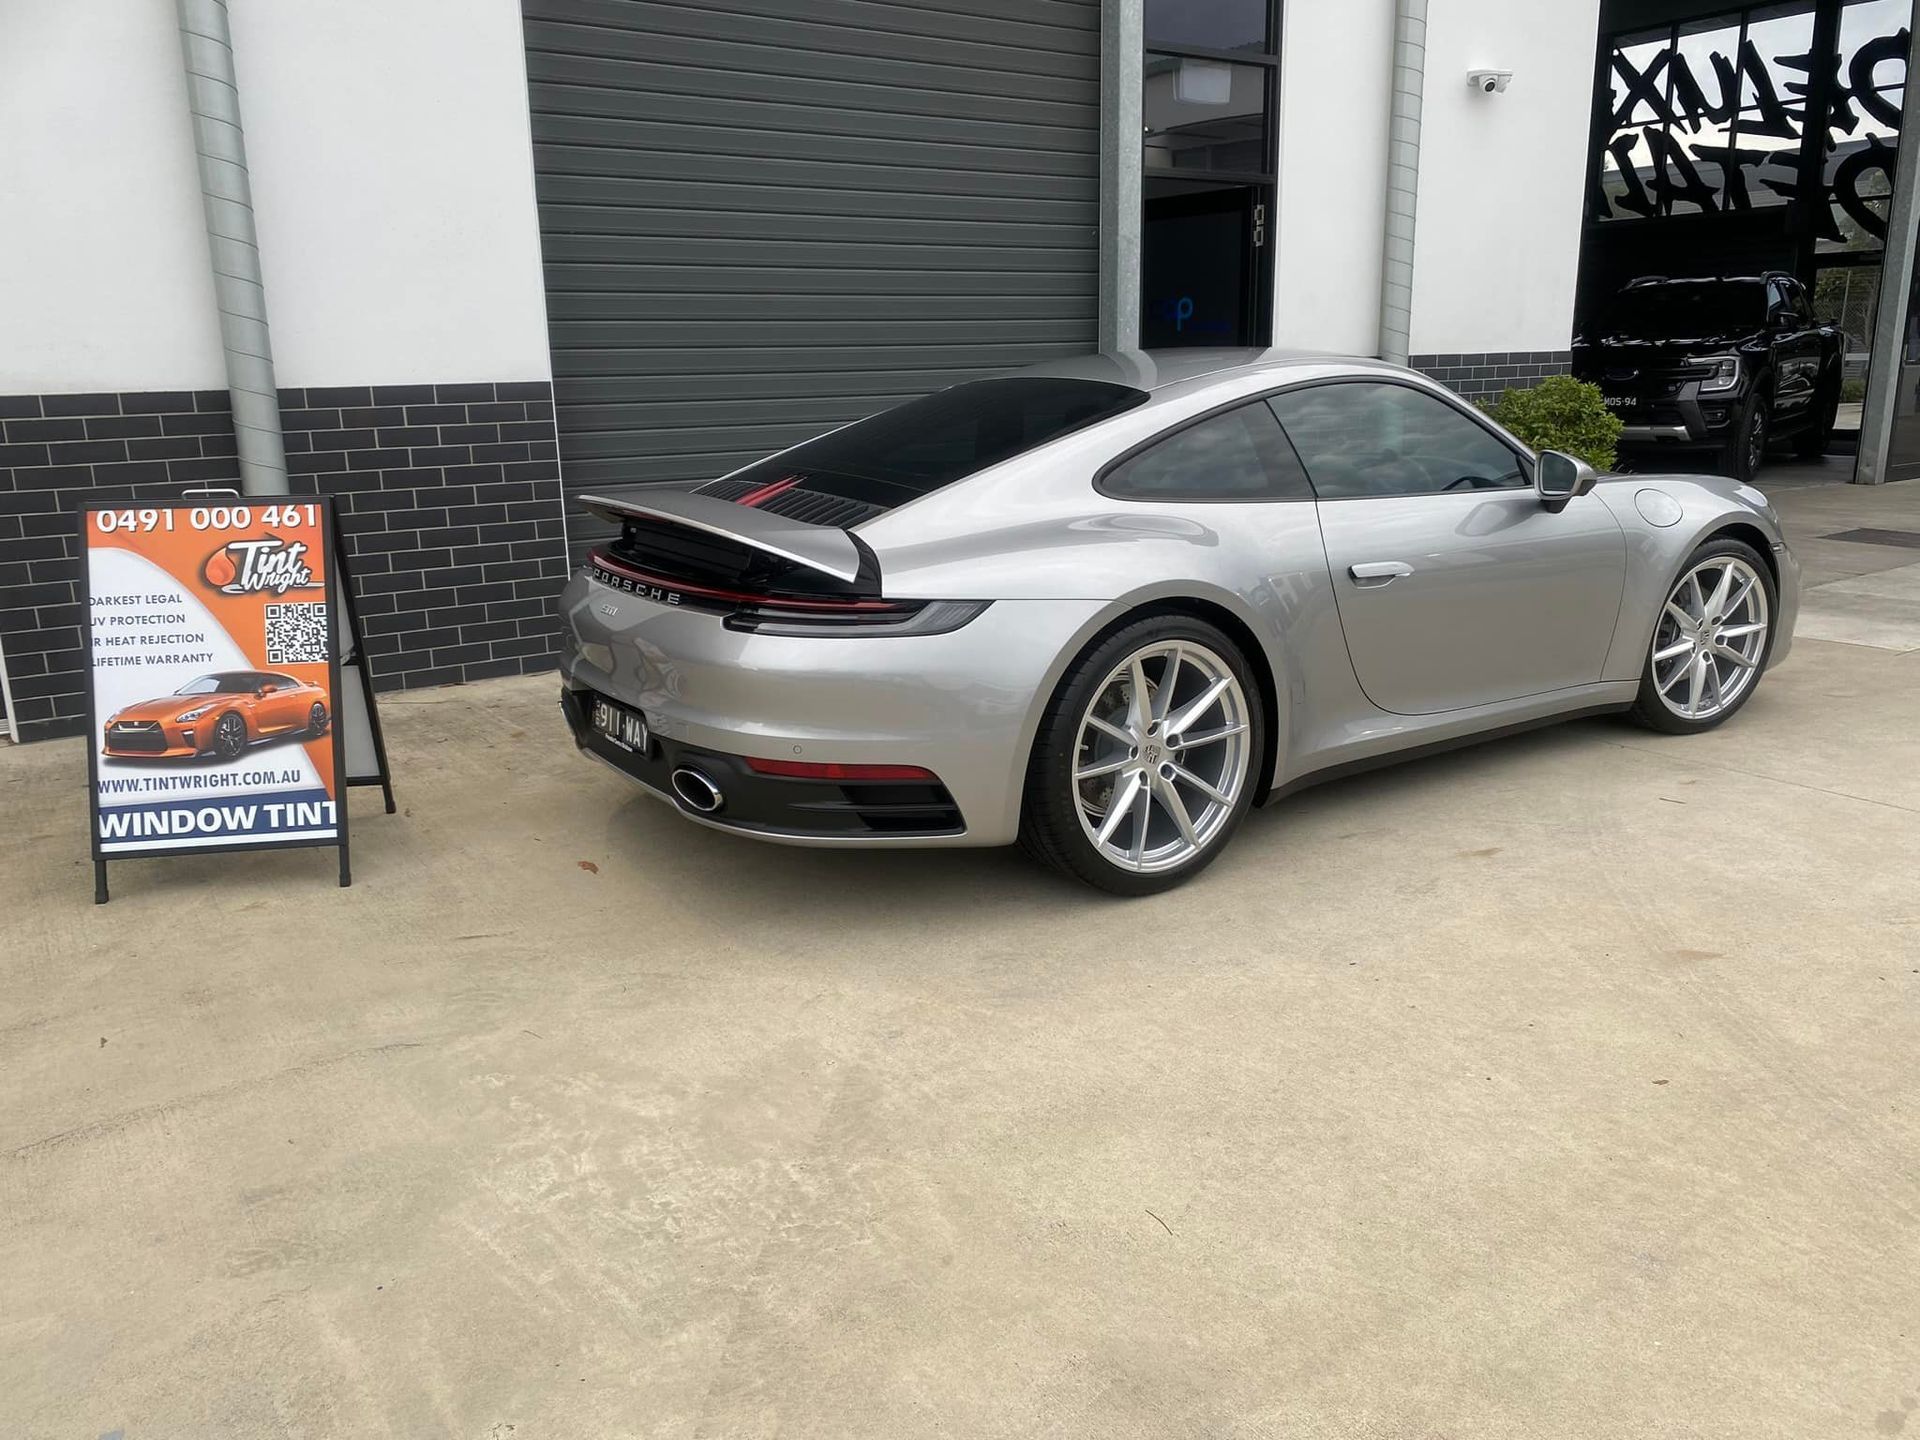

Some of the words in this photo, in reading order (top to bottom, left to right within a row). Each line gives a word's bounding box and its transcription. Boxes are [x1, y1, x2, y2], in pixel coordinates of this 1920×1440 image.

[96, 507, 174, 532] 0491
[190, 505, 251, 530] 000
[261, 504, 316, 528] 461
[227, 540, 307, 586] Tint
[244, 567, 311, 593] Wright
[593, 569, 681, 605] PORSCHE
[89, 595, 141, 606] DARKEST
[146, 594, 182, 604] LEGAL
[600, 604, 618, 616] 911
[110, 614, 186, 626] PROTECTION
[106, 636, 136, 646] HEAT
[140, 633, 204, 645] REJECTION
[145, 653, 213, 665] WARRANTY
[98, 769, 301, 794] WWW.TINTWRIGHT.COM.AU
[99, 804, 258, 839] WINDOW
[263, 800, 337, 828] TINT
